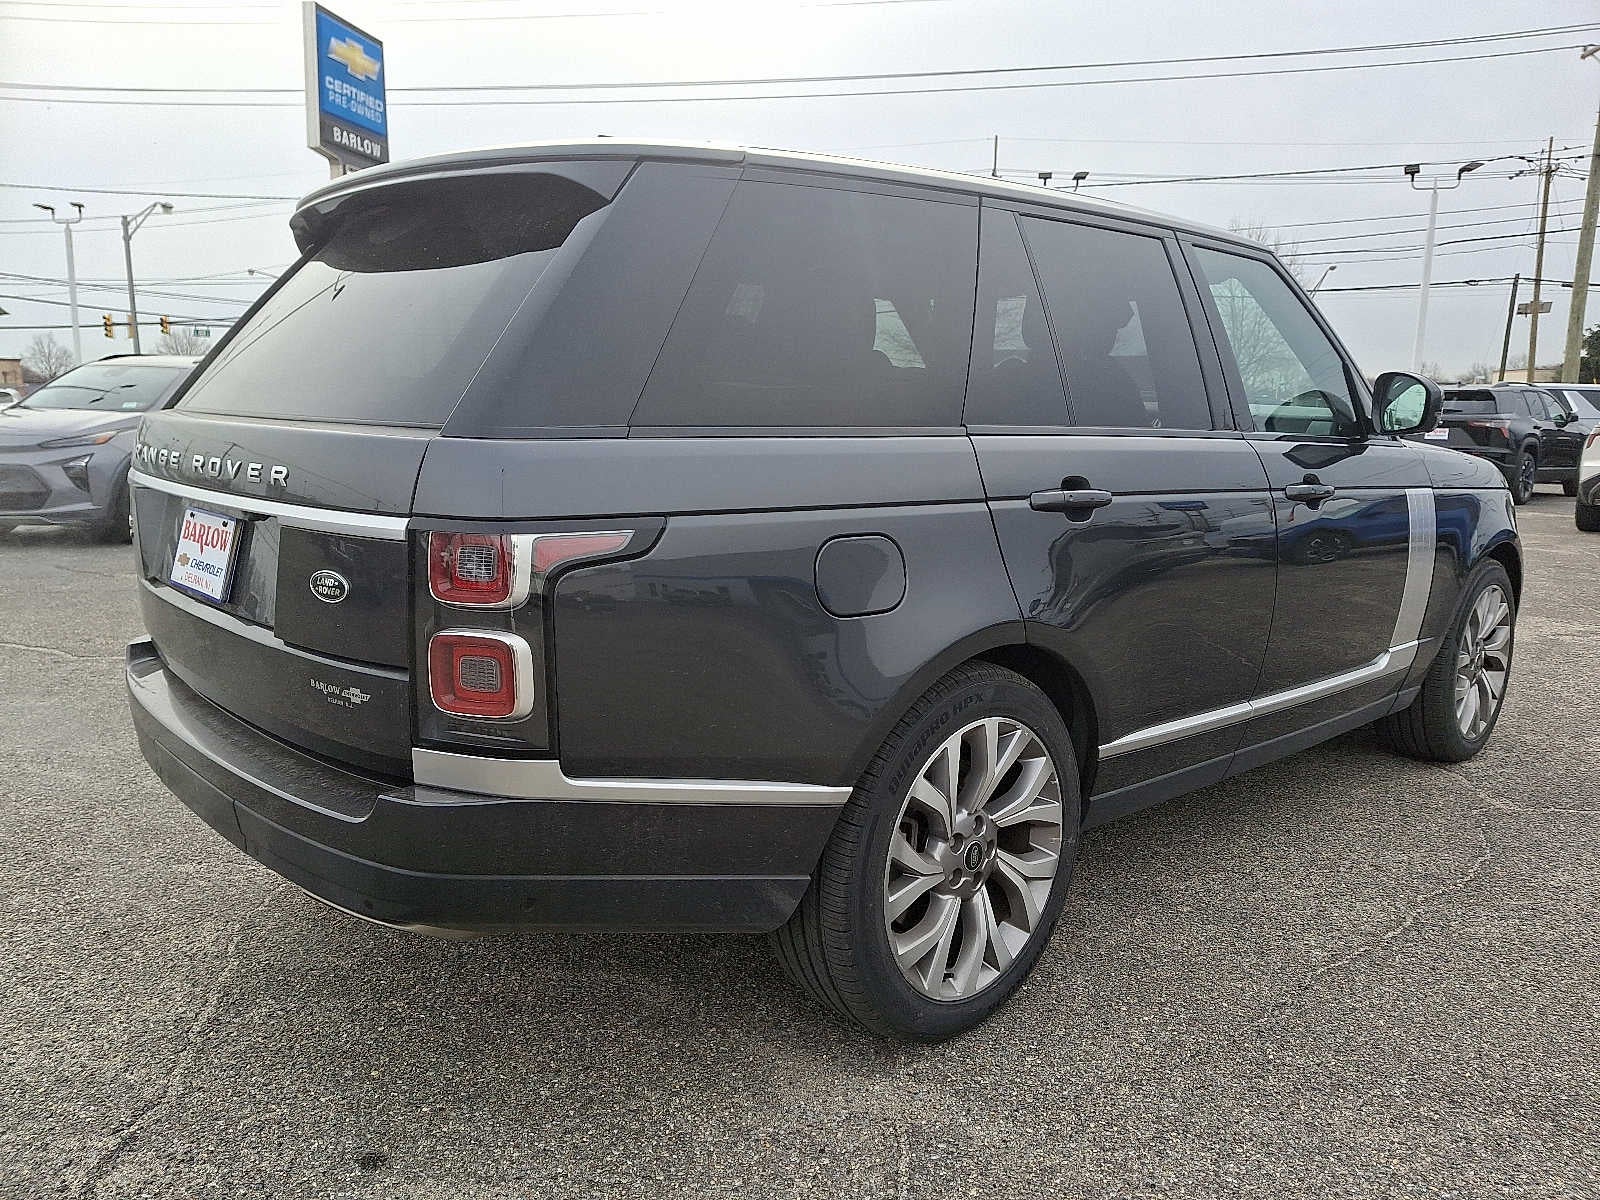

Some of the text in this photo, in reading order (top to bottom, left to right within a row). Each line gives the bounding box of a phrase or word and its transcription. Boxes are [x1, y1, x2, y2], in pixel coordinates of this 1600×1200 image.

[325, 76, 384, 112] CERTIFIED
[329, 91, 382, 124] PRE-OWNED
[333, 127, 381, 158] BARLOW
[136, 443, 289, 488] RANGE ROVER
[182, 519, 231, 556] BARLOW
[190, 558, 223, 578] CHEVROLET
[317, 576, 335, 587] LAND
[318, 586, 341, 597] ROVER
[310, 678, 340, 695] BARLOW
